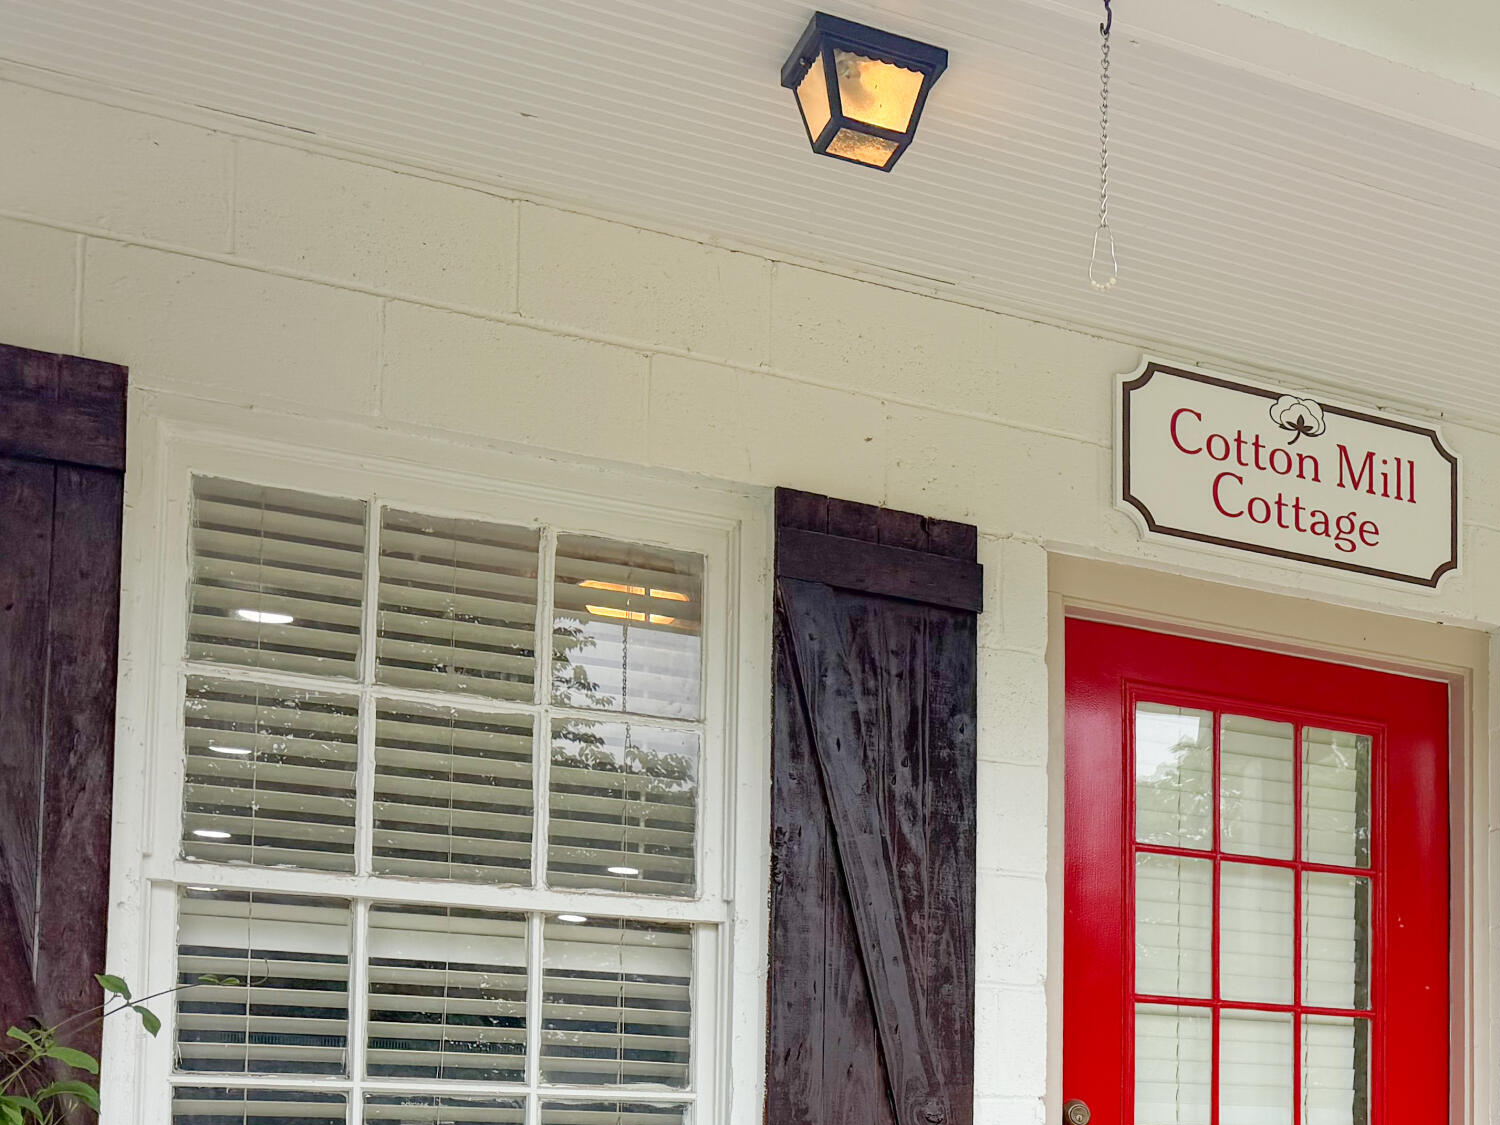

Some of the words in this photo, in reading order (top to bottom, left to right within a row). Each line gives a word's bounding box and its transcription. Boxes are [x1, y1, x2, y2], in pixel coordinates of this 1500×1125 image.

[1170, 407, 1321, 483] Cotton
[1336, 443, 1417, 504] Mill
[1212, 471, 1380, 553] Cottage
